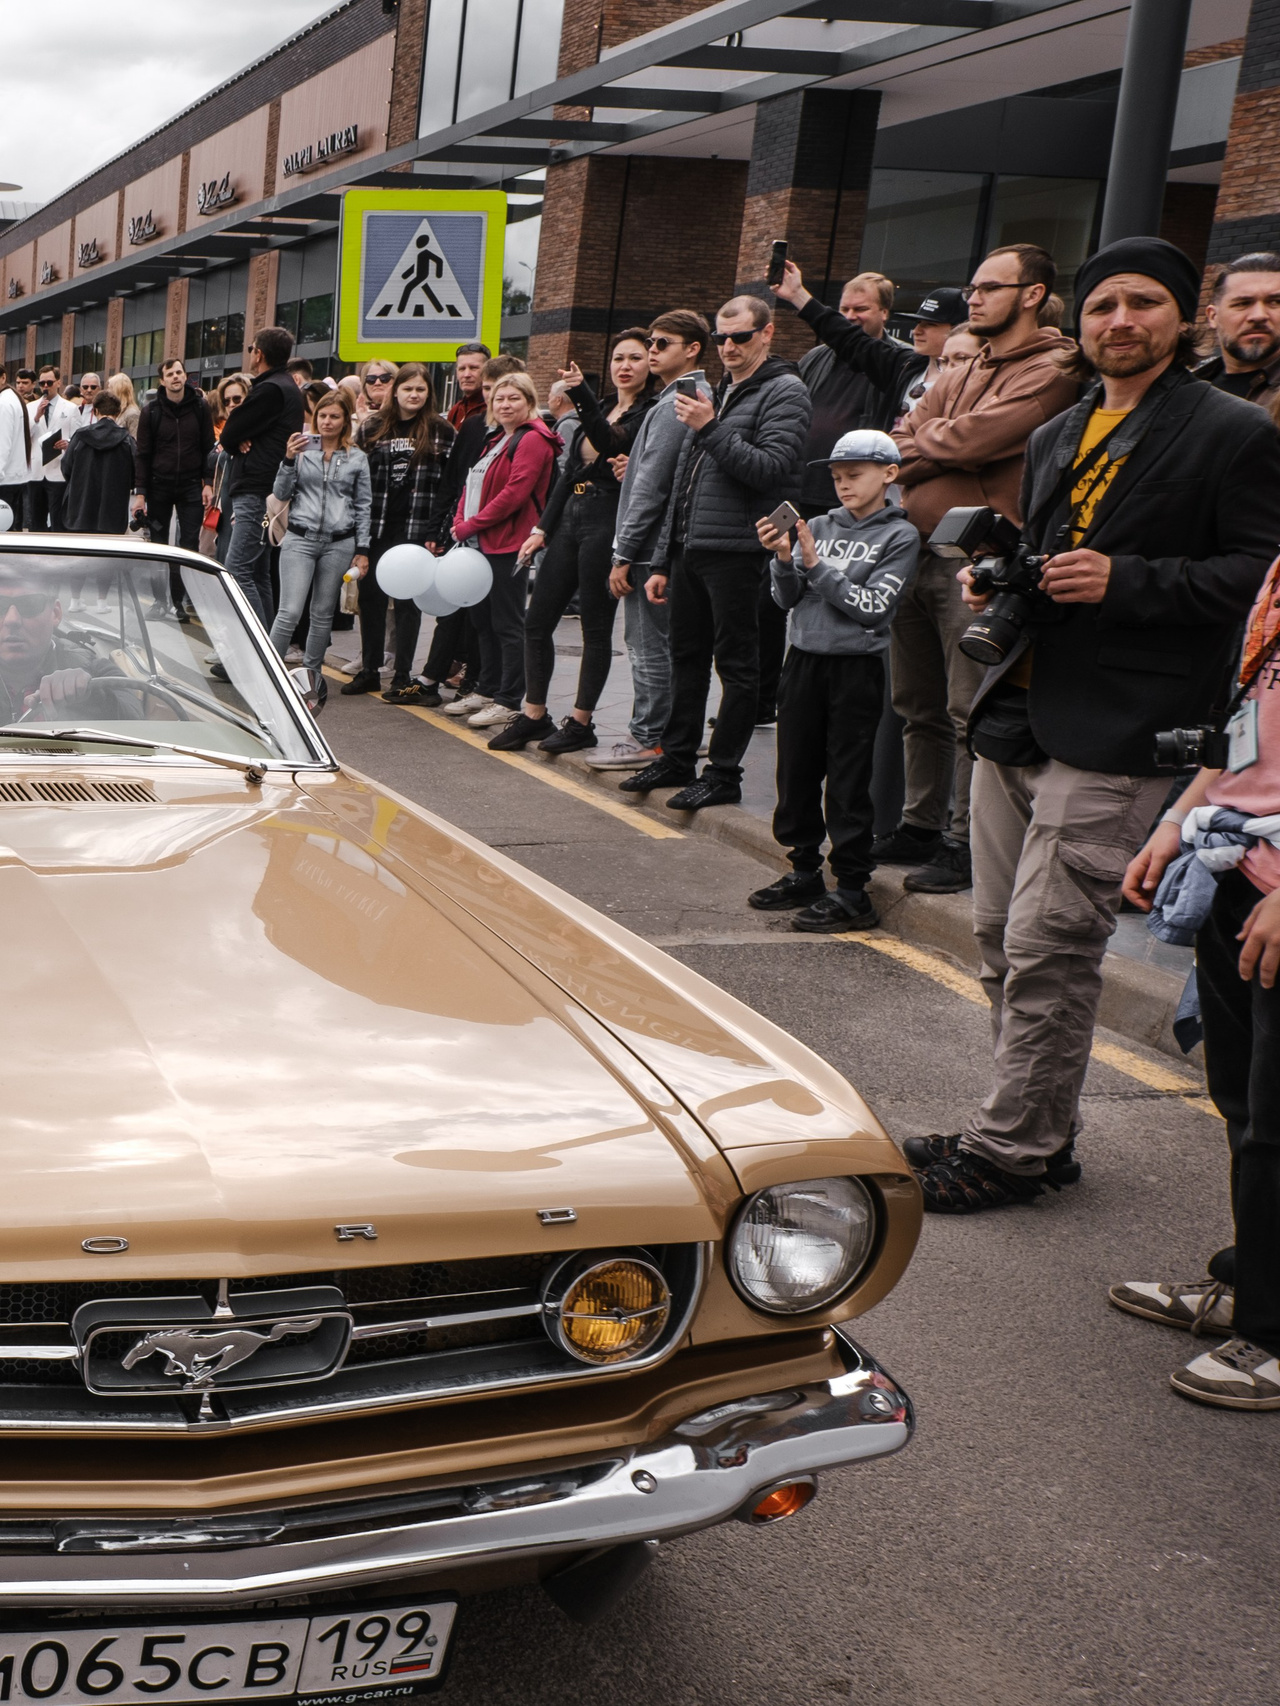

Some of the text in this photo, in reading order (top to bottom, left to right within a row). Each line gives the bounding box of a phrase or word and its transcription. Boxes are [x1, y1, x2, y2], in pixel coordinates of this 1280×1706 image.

[283, 124, 358, 176] RALPH LAUREN
[317, 1609, 431, 1664] 199
[331, 1660, 388, 1682] RUS
[297, 1686, 414, 1706] www.g-car.ru
